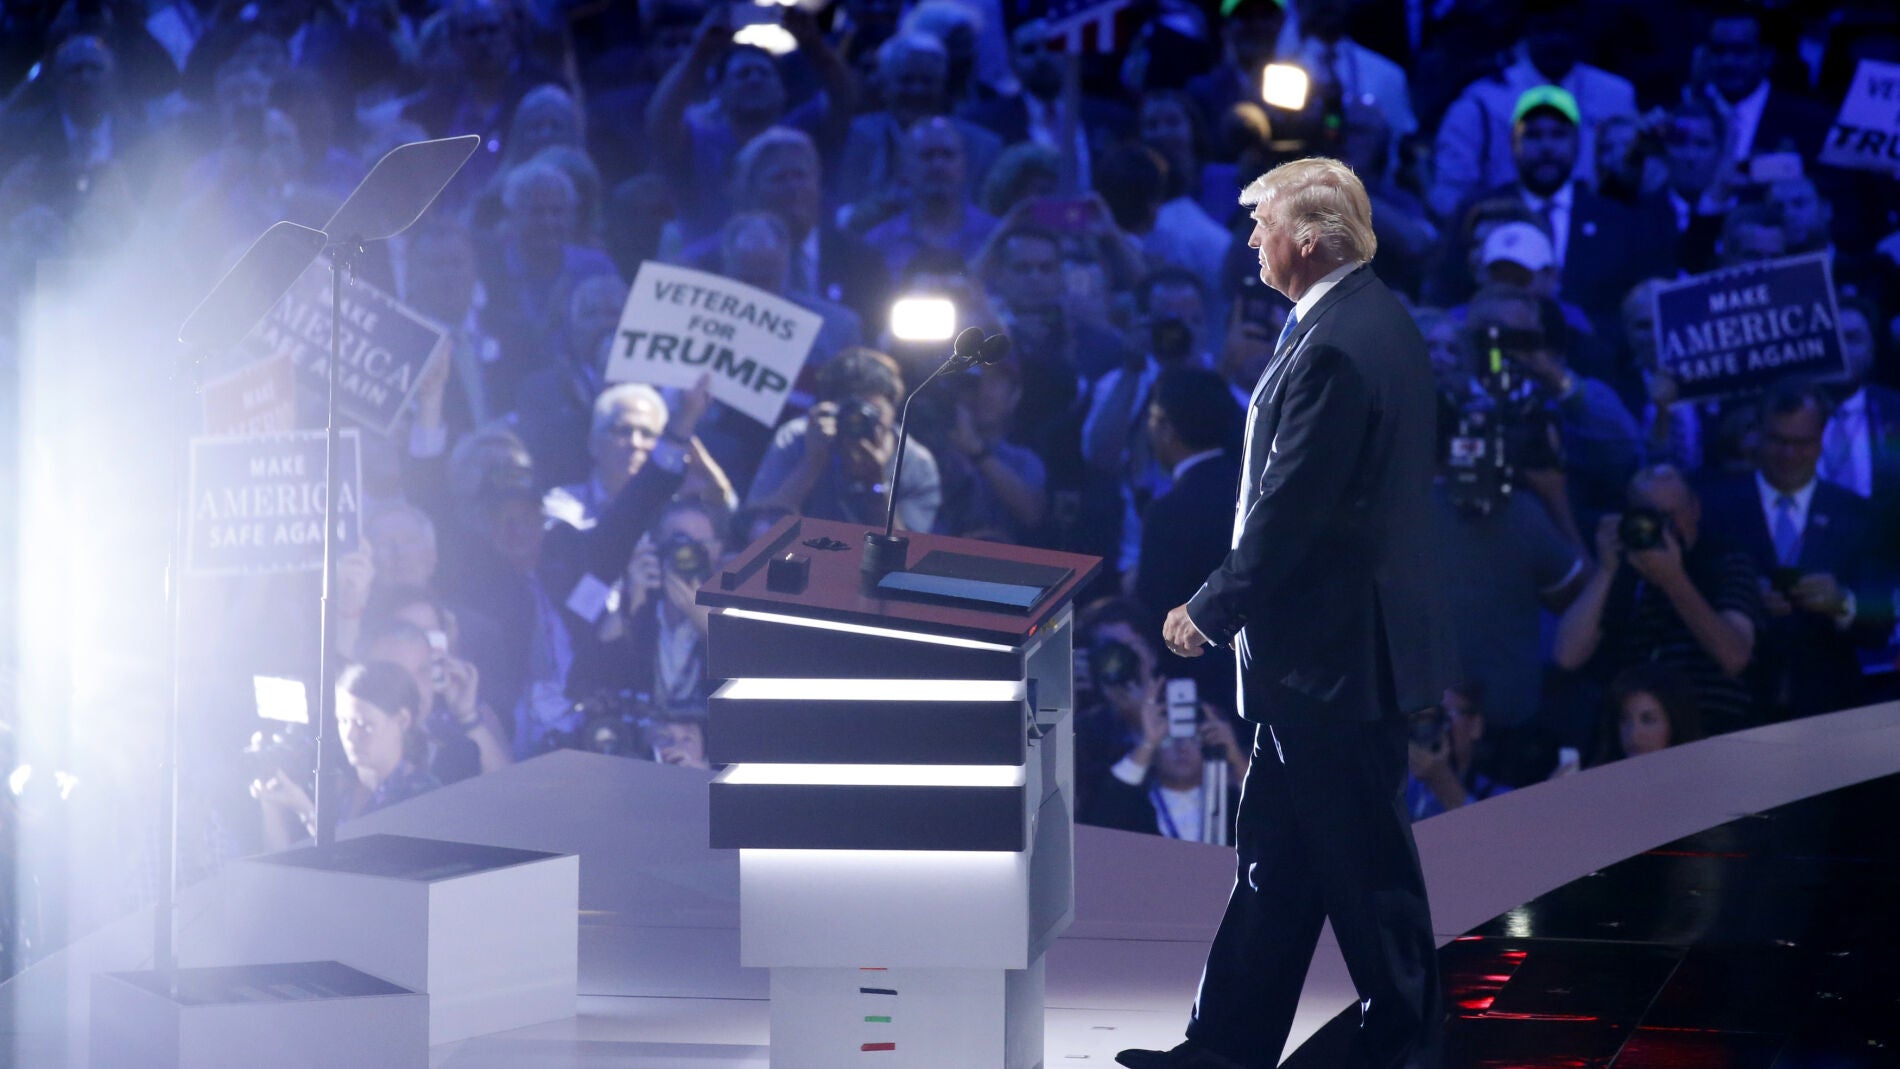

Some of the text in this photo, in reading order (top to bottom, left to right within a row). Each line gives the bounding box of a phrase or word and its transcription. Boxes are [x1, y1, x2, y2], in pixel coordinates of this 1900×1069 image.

[1867, 76, 1900, 100] VE
[654, 279, 797, 342] VETERANS
[1709, 283, 1770, 314] MAKE
[271, 293, 412, 395] MERICA
[687, 314, 737, 342] FOR
[1664, 301, 1834, 362] AMERICA
[621, 329, 789, 394] TRUMP
[1678, 336, 1826, 383] SAFE AGAIN
[250, 453, 305, 478] MAKE
[197, 481, 357, 521] AMERICA
[209, 521, 265, 549] SAFE
